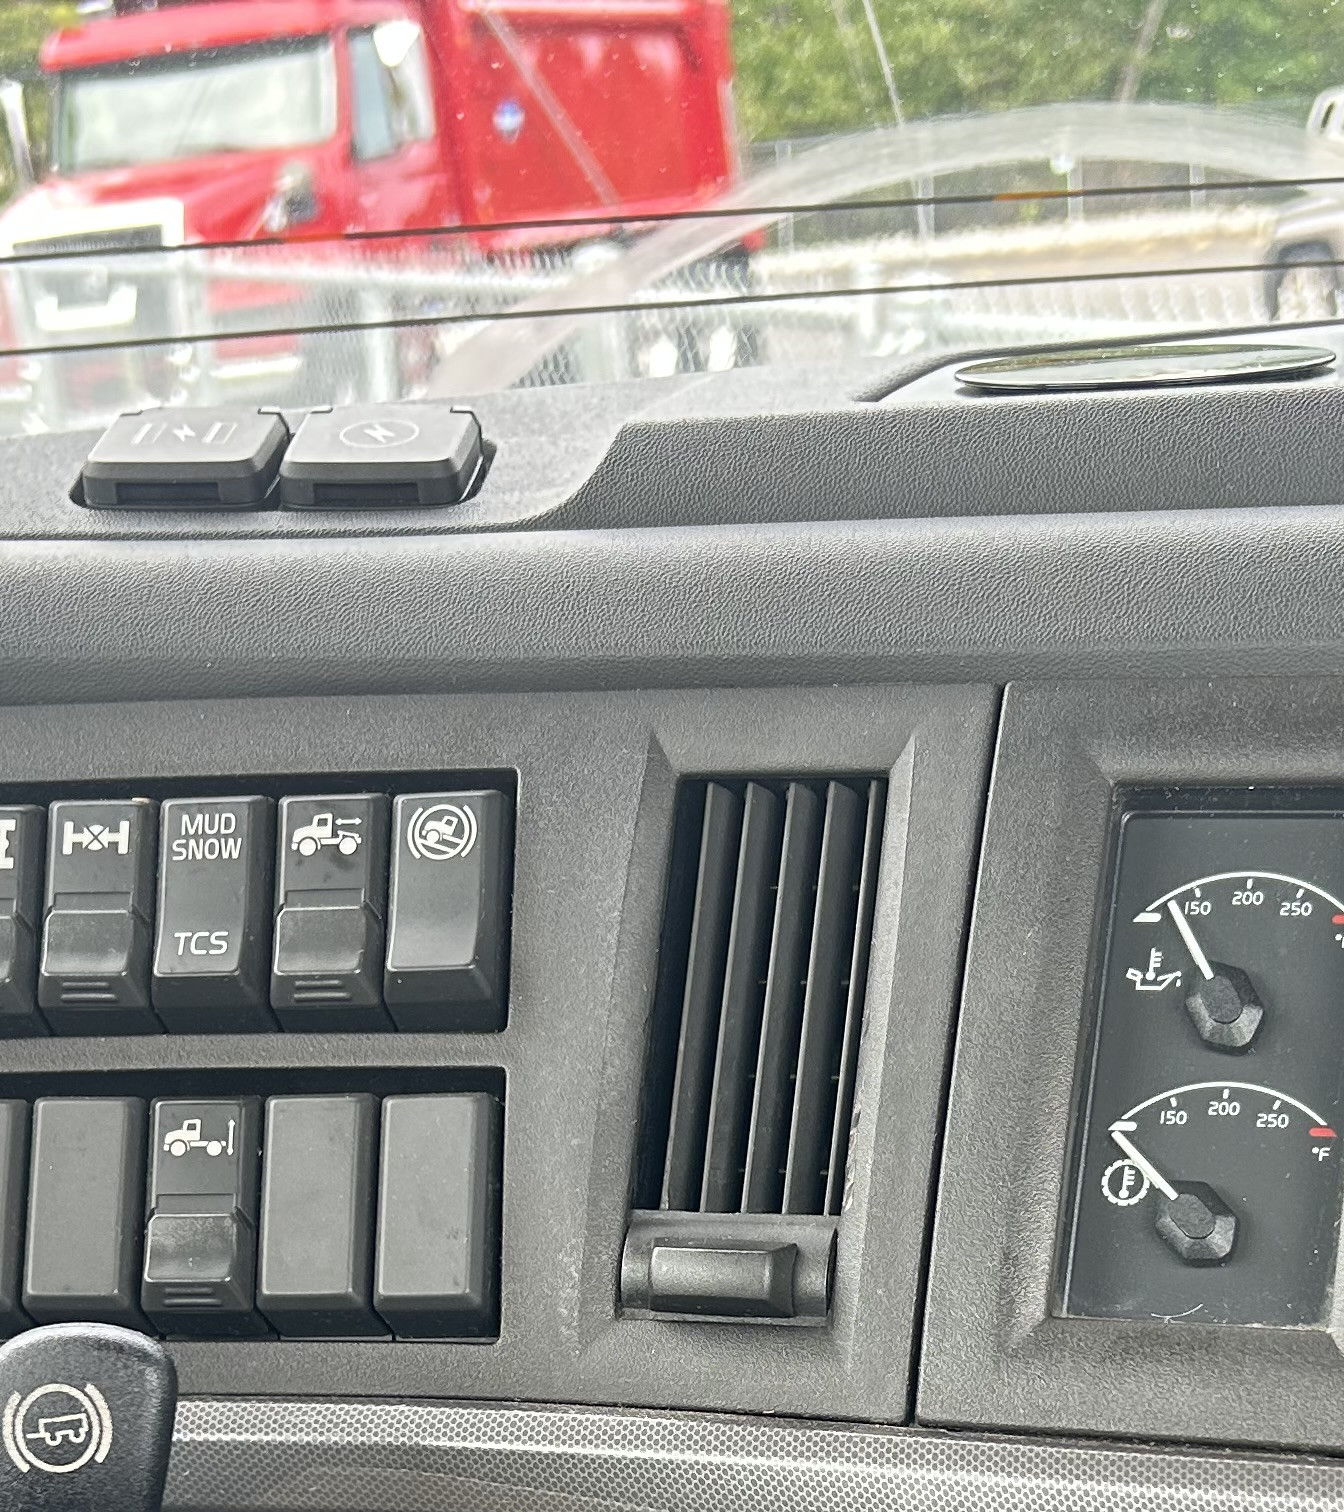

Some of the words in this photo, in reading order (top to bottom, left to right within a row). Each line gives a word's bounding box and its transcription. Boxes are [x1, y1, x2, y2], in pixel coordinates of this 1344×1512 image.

[180, 813, 236, 836] MUD
[172, 837, 242, 861] SNOW
[1185, 901, 1211, 916] 150
[1232, 891, 1264, 905] 200
[1280, 903, 1312, 917] 250
[174, 931, 229, 956] TCS
[1160, 1110, 1187, 1125] 150
[1208, 1101, 1240, 1116] 200
[1256, 1113, 1289, 1128] 250
